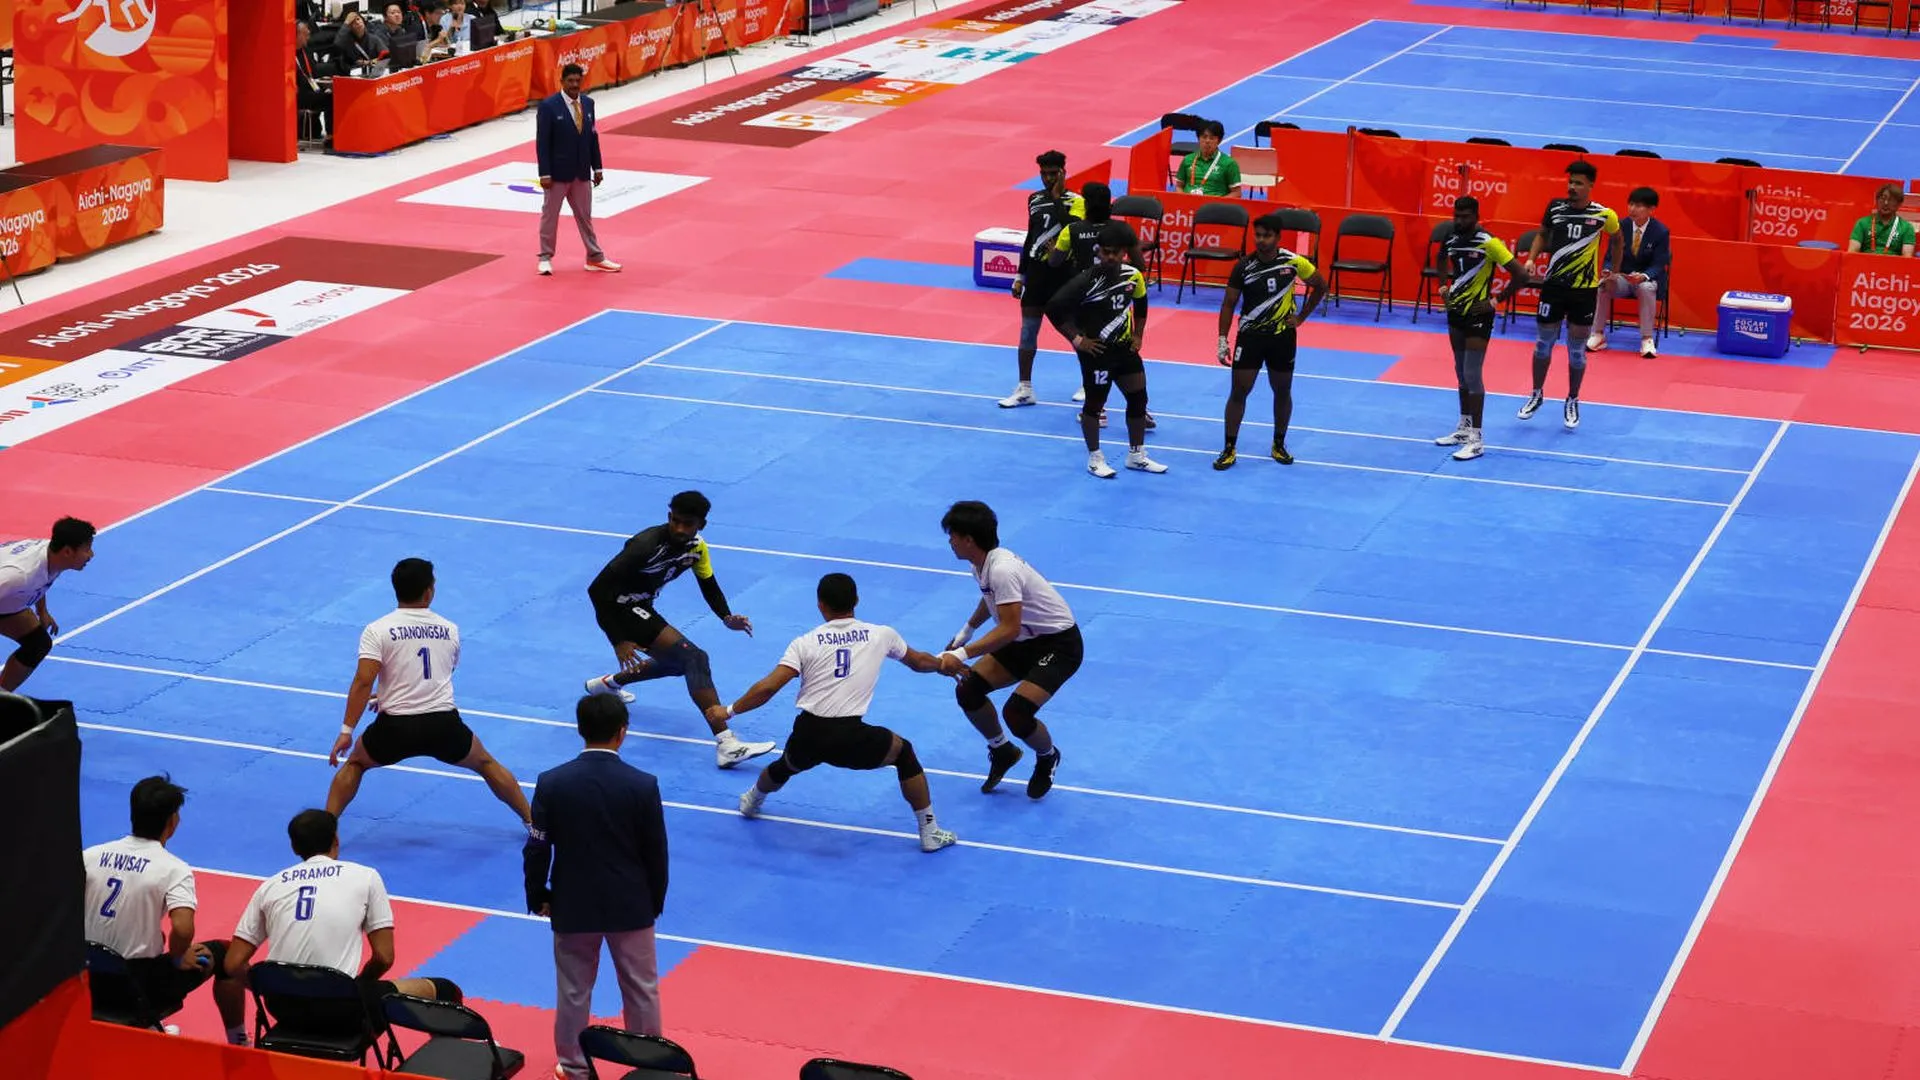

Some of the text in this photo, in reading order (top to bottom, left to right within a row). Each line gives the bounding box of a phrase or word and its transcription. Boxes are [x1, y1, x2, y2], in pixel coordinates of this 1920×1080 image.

[78, 178, 152, 211] Aichi-Nagoya
[102, 204, 129, 225] 2026
[1043, 213, 1051, 229] 7
[1754, 202, 1828, 223] Nagoya
[1567, 223, 1583, 239] 10
[1753, 222, 1799, 238] 2026
[1458, 258, 1464, 272] 1
[1267, 279, 1277, 292] 9
[1852, 271, 1920, 292] Aichi-
[28, 281, 220, 347] Aichi-Nagoya
[203, 262, 281, 286] 2026
[292, 286, 361, 307] TOYOTA
[1111, 293, 1125, 310] 12
[1539, 301, 1551, 317] 10
[1734, 319, 1768, 328] POCARI
[1734, 325, 1764, 333] SWEAT
[1850, 313, 1906, 332] 2026
[1234, 346, 1243, 362] 9
[120, 357, 167, 372] NTT
[1094, 370, 1109, 385] 12
[389, 625, 451, 641] S.TANONGSAK
[816, 629, 869, 645] P.SAHARAT
[417, 646, 432, 680] 1
[834, 649, 851, 678] 9
[99, 852, 151, 874] W.WISAT
[281, 864, 343, 883] S.PRAMOT
[99, 877, 124, 918] 2
[294, 885, 317, 921] 6
